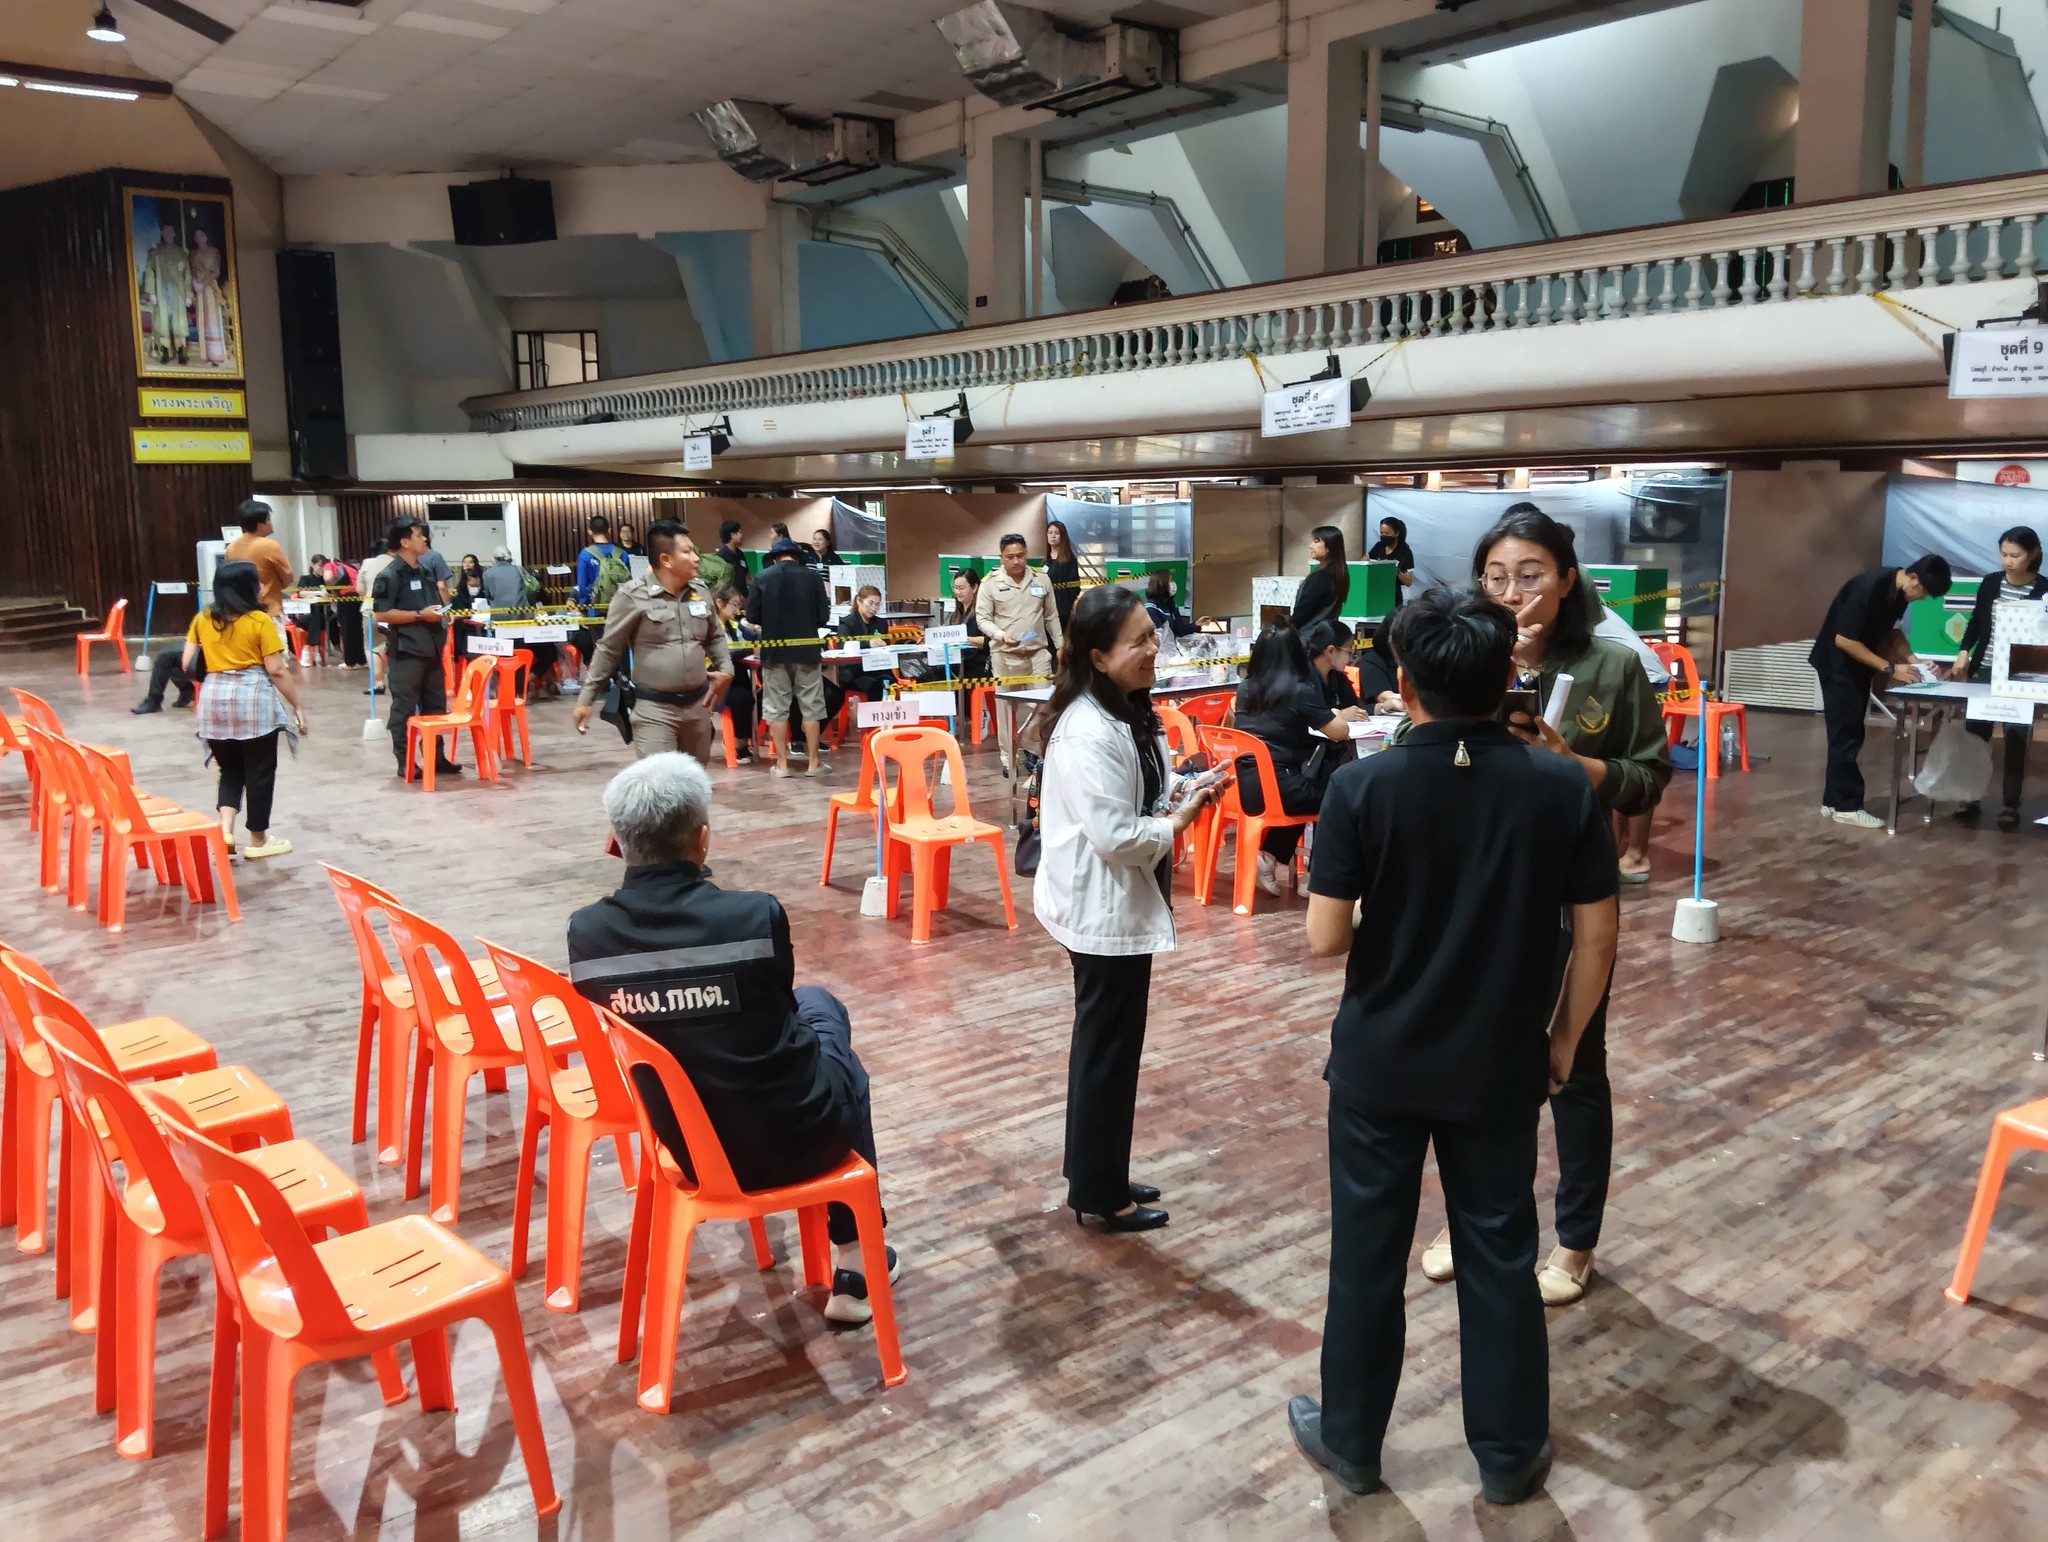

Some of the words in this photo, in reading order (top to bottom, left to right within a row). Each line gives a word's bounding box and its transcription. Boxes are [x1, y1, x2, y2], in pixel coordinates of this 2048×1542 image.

[2001, 336, 2028, 361] ชุดที่
[2033, 341, 2044, 354] 9
[151, 395, 233, 412] ทรงพระเจริญ
[872, 705, 907, 722] ทางเข้า
[609, 985, 731, 1015] สนง.กกต.
